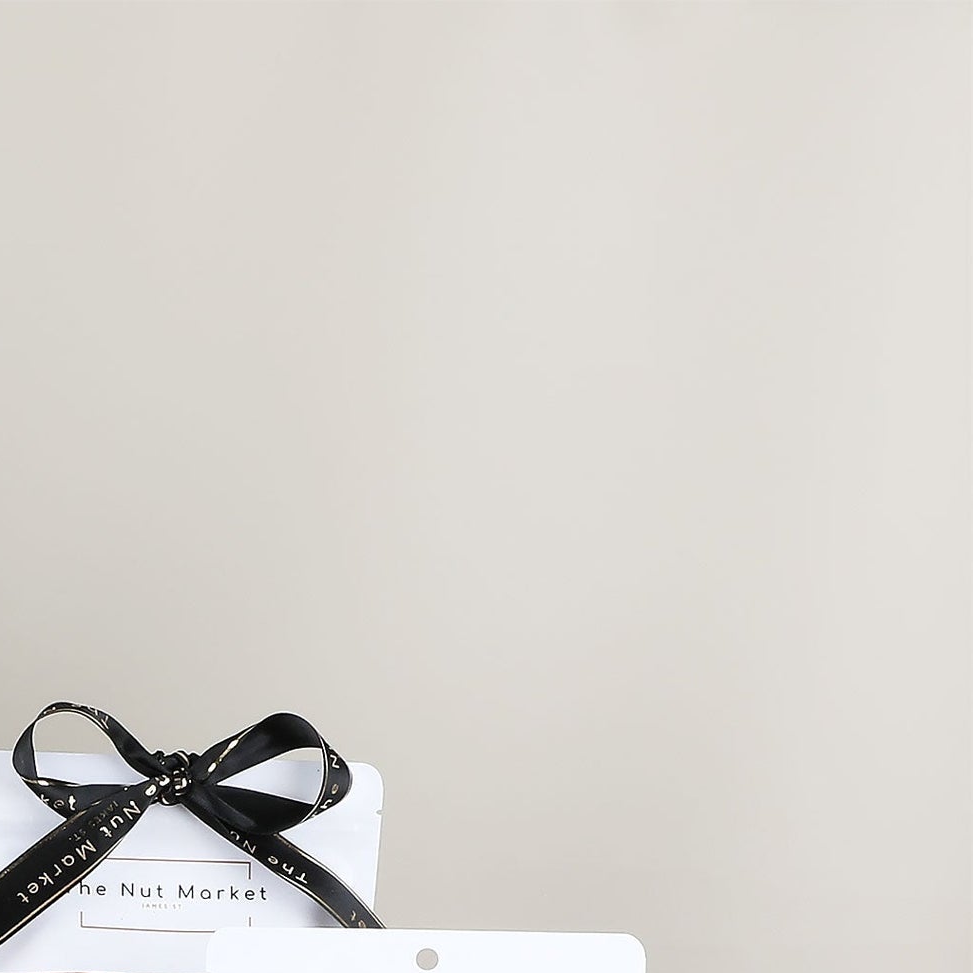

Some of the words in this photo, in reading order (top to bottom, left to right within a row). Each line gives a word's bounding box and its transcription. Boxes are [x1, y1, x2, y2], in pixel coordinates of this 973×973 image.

[16, 838, 98, 904] Market
[78, 882, 107, 897] he
[120, 882, 164, 899] Nut
[178, 884, 268, 901] Market
[141, 902, 168, 910] JAMES
